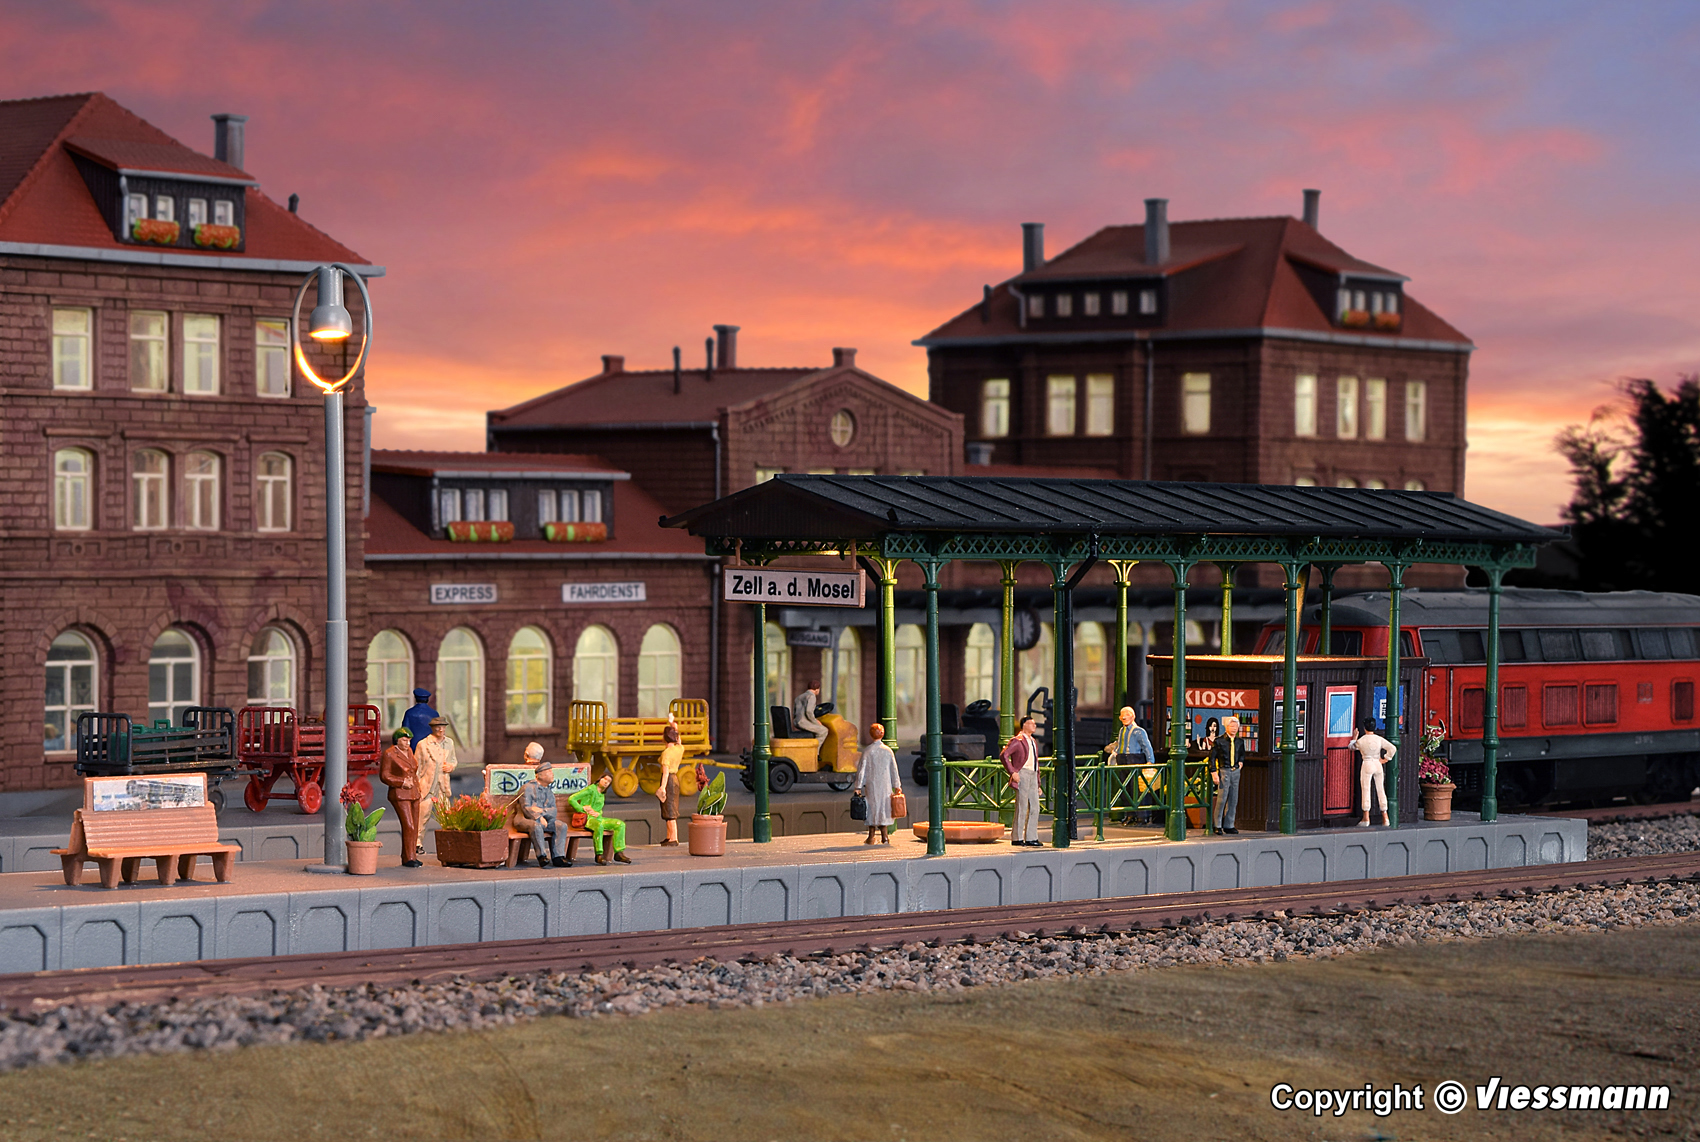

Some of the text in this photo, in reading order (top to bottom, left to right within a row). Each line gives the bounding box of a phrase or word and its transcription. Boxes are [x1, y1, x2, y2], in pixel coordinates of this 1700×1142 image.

[435, 586, 494, 600] EXPRESS
[570, 585, 640, 599] FAHRDIENST
[732, 575, 855, 599] Zell a. d. Mosel
[1185, 690, 1245, 707] KIOSK
